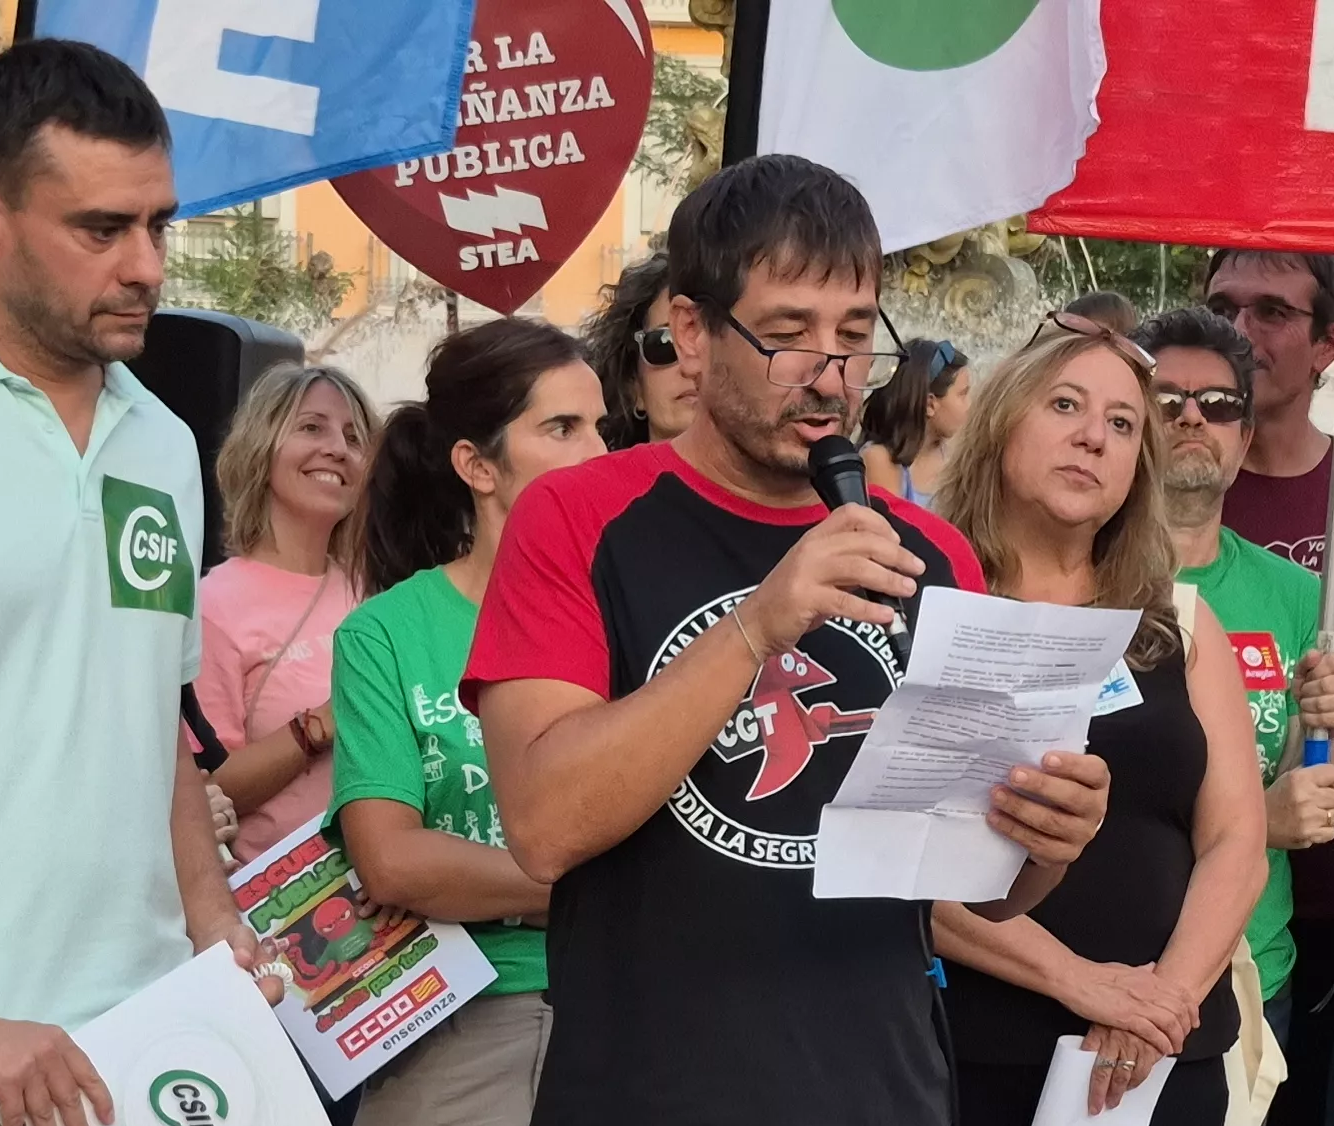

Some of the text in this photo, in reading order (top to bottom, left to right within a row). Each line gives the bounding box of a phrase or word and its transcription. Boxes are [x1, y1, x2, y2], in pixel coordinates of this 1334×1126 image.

[494, 32, 555, 70] LA
[456, 76, 615, 127] ÑANZA
[459, 239, 539, 271] STEA
[133, 529, 178, 564] CSIF
[1301, 555, 1318, 567] LA
[718, 702, 778, 748] CGT
[714, 827, 746, 854] LA
[750, 838, 816, 862] SEGR
[342, 995, 414, 1053] CCOO
[381, 989, 457, 1052] enseñanza
